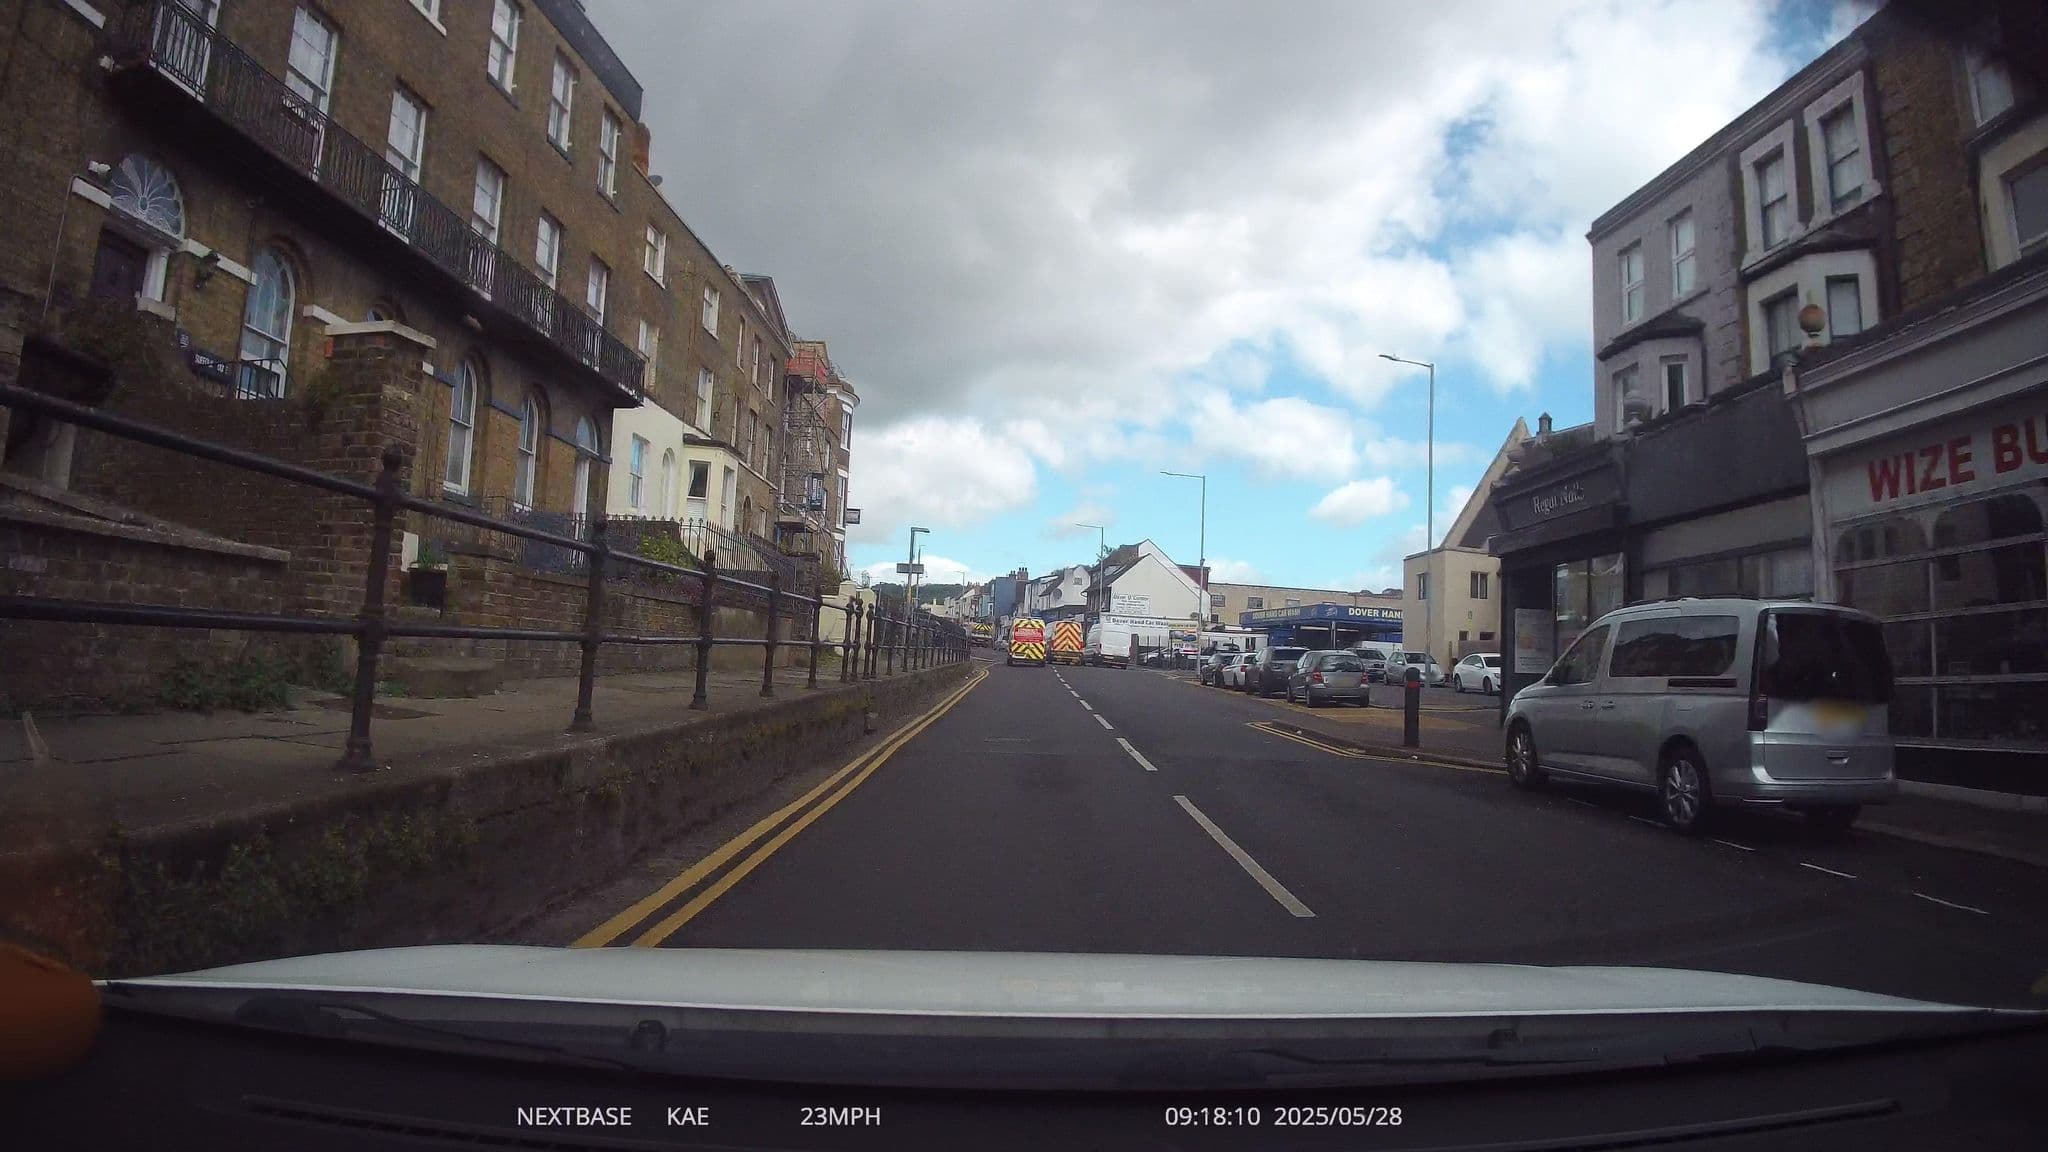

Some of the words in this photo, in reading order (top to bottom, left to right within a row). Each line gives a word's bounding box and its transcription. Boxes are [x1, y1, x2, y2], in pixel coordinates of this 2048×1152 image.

[1868, 435, 1976, 502] WIZE
[1533, 495, 1558, 515] Regal
[1349, 607, 1379, 617] DOVER
[1381, 609, 1403, 619] HAN
